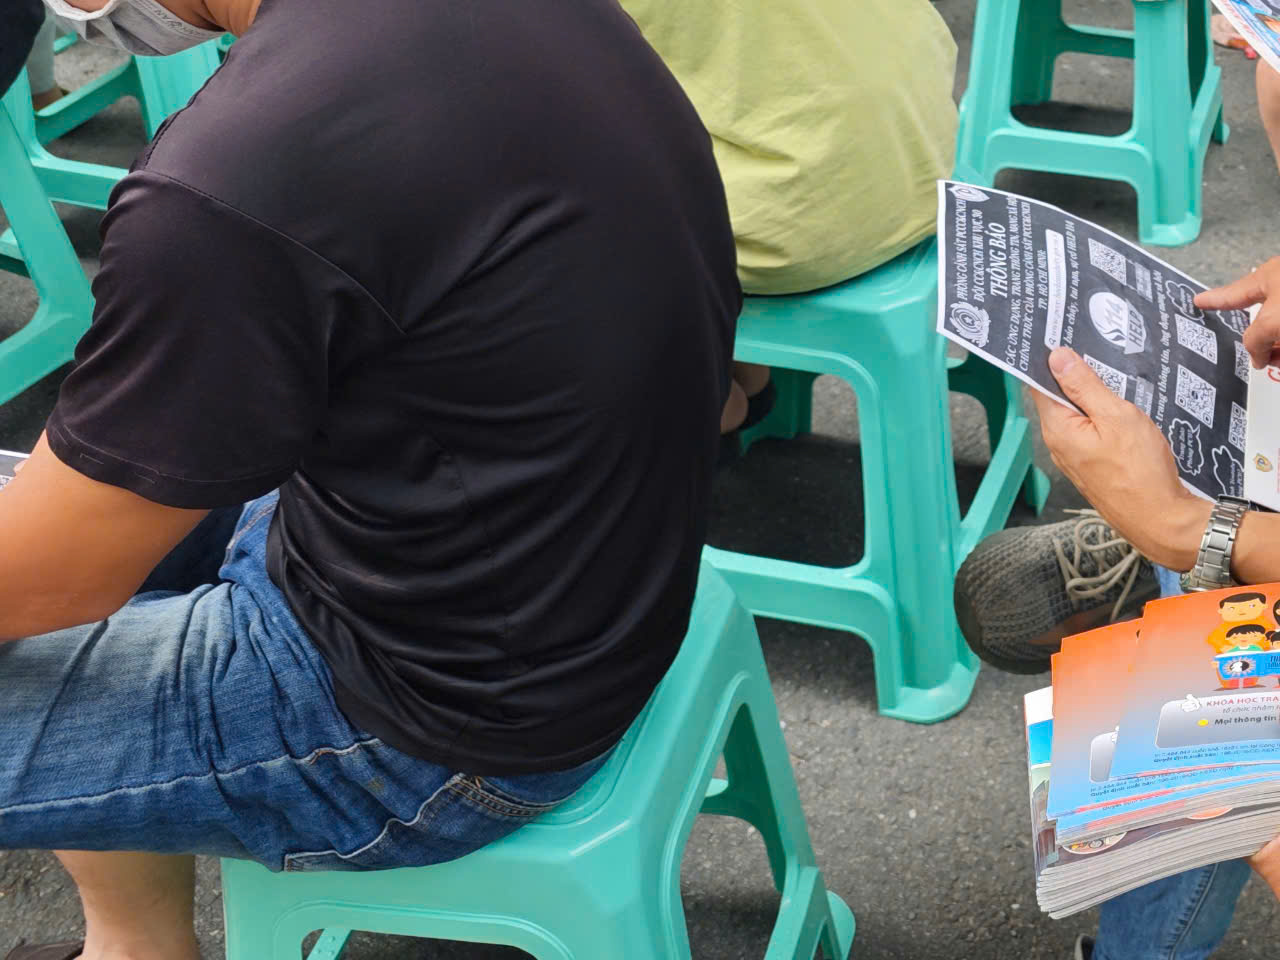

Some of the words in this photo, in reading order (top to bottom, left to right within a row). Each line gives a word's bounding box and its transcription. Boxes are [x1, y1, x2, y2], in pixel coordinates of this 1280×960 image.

[984, 222, 1006, 249] BÁO
[1065, 220, 1074, 231] 114
[1066, 231, 1076, 251] HELP
[1009, 247, 1020, 270] THÔNG
[954, 272, 968, 300] PHÒNG
[986, 250, 1007, 298] THÔNG
[1011, 271, 1021, 296] TRANG
[1024, 269, 1034, 296] PHÒNG
[1036, 269, 1047, 283] CHÍ
[1037, 284, 1047, 296] HỒ
[1070, 288, 1078, 299] tai
[1023, 297, 1034, 313] CỦA
[1104, 299, 1122, 328] 114
[1022, 313, 1033, 338] THỨC
[1064, 326, 1073, 344] báo
[1129, 309, 1142, 347] HELP
[1005, 345, 1016, 366] CÁC
[1019, 339, 1031, 371] CHÍNH
[1161, 349, 1171, 363] tin,
[1157, 364, 1170, 392] thông
[1156, 393, 1167, 421] trang
[1214, 717, 1232, 726] Mọi
[1234, 715, 1261, 723] thông
